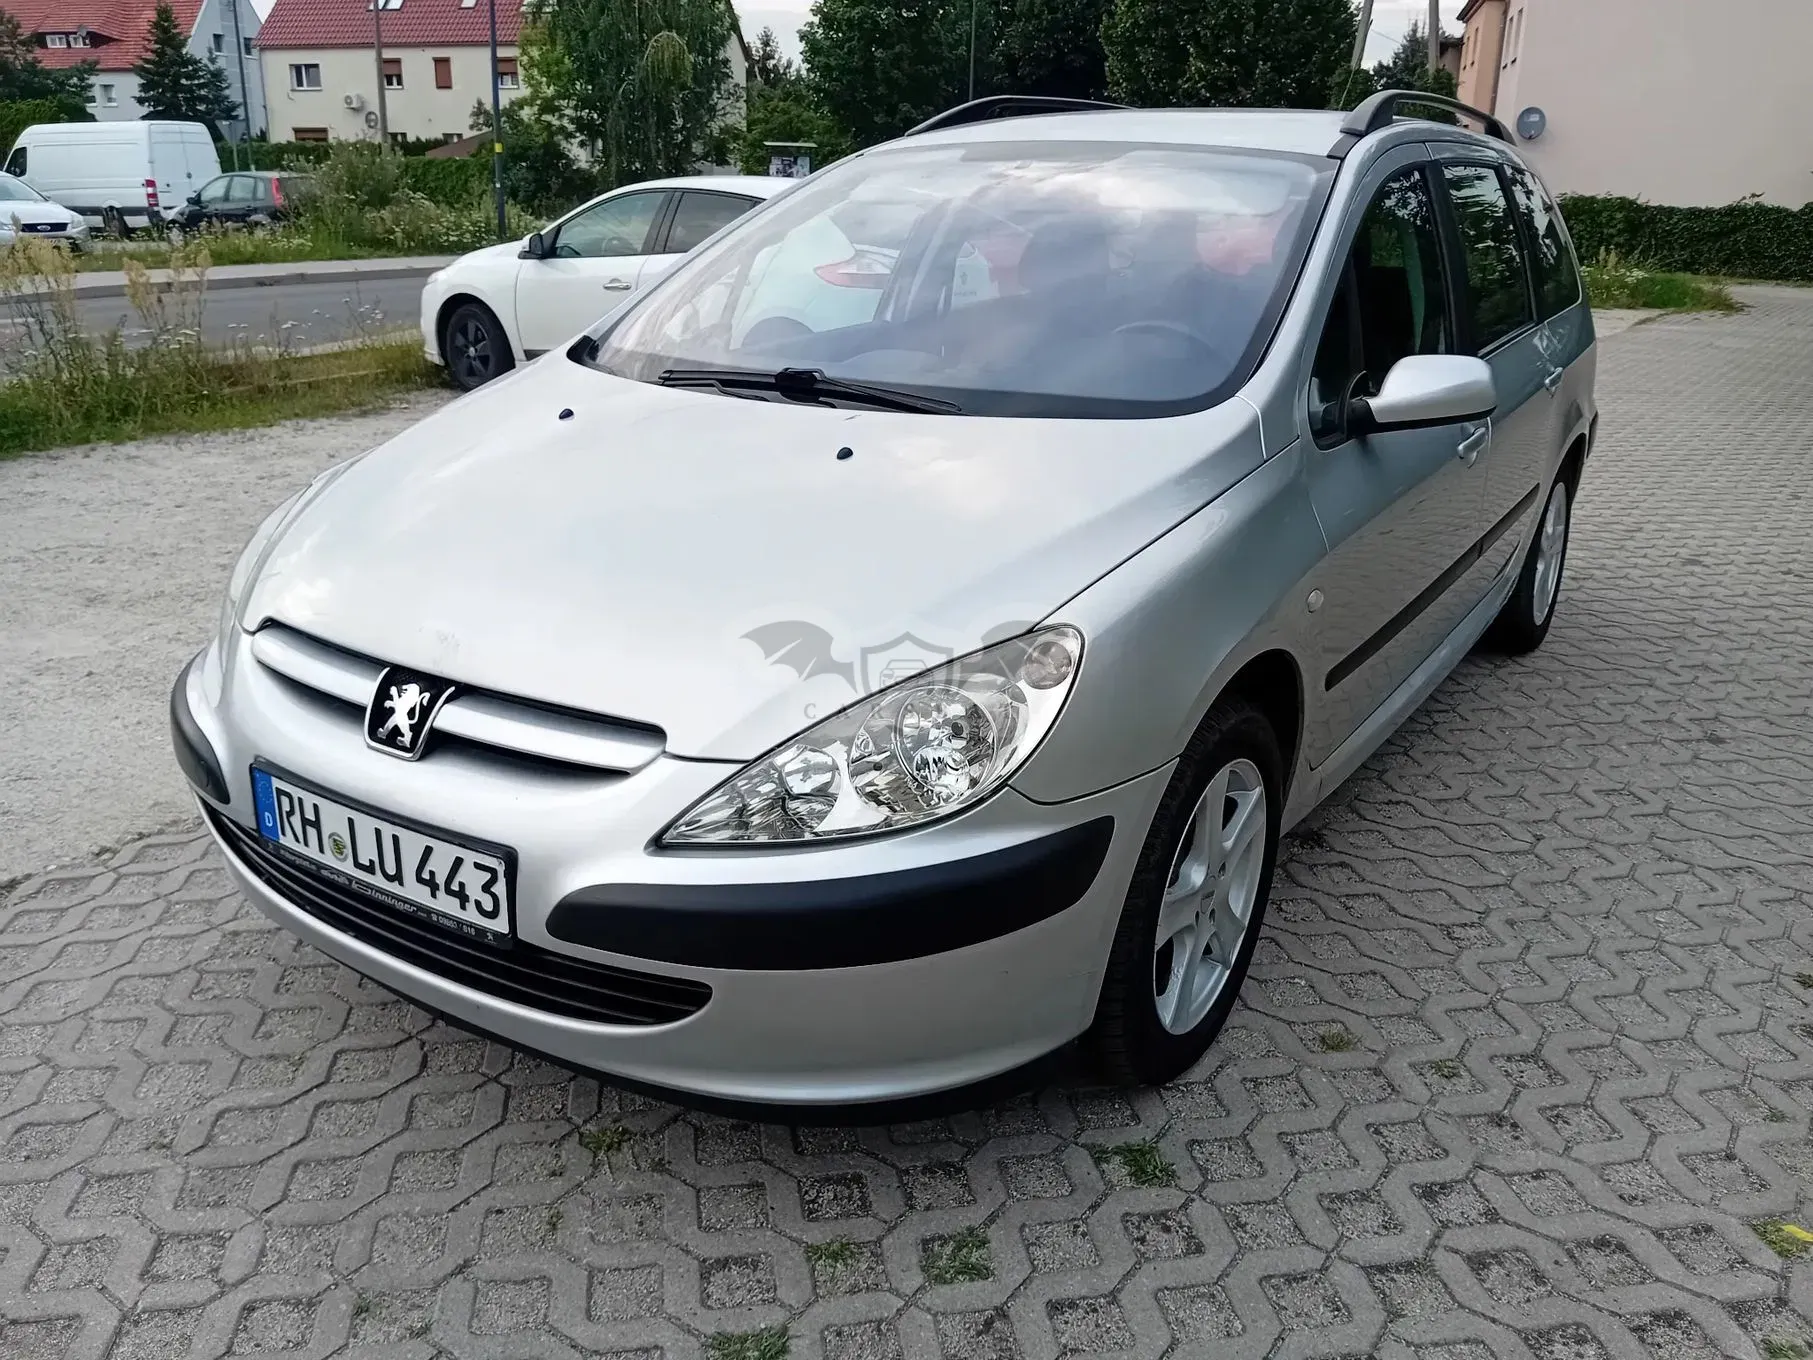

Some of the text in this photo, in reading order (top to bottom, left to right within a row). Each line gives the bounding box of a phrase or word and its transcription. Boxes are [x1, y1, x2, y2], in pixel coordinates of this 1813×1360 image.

[264, 811, 274, 828] D
[275, 786, 501, 920] RH LU 443
